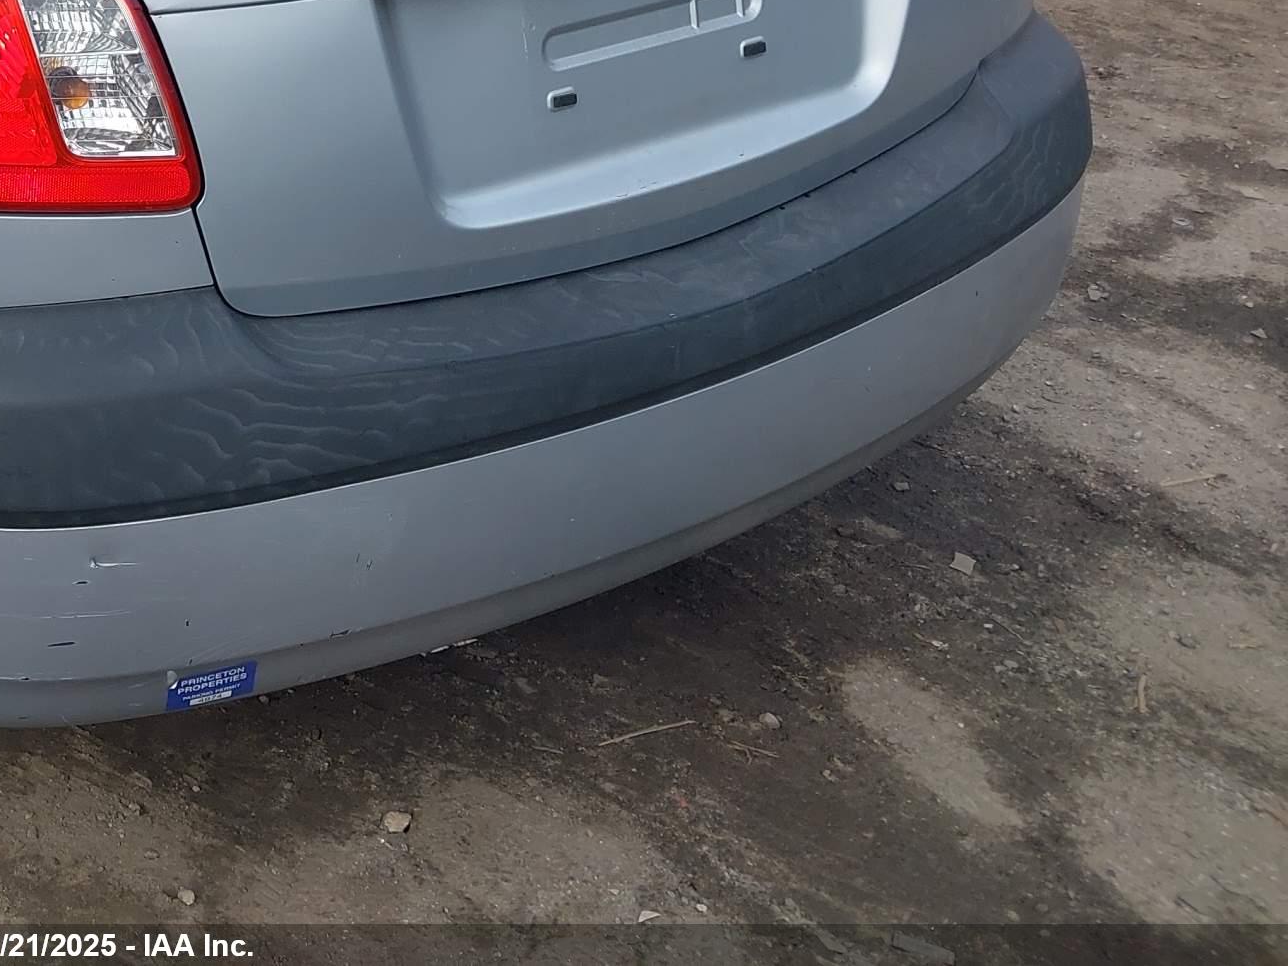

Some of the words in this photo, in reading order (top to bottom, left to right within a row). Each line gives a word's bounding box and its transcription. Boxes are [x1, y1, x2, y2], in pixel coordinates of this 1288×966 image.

[177, 672, 248, 695] PROPERTIES
[180, 666, 245, 688] PRINCETON
[215, 683, 241, 694] PERMIT
